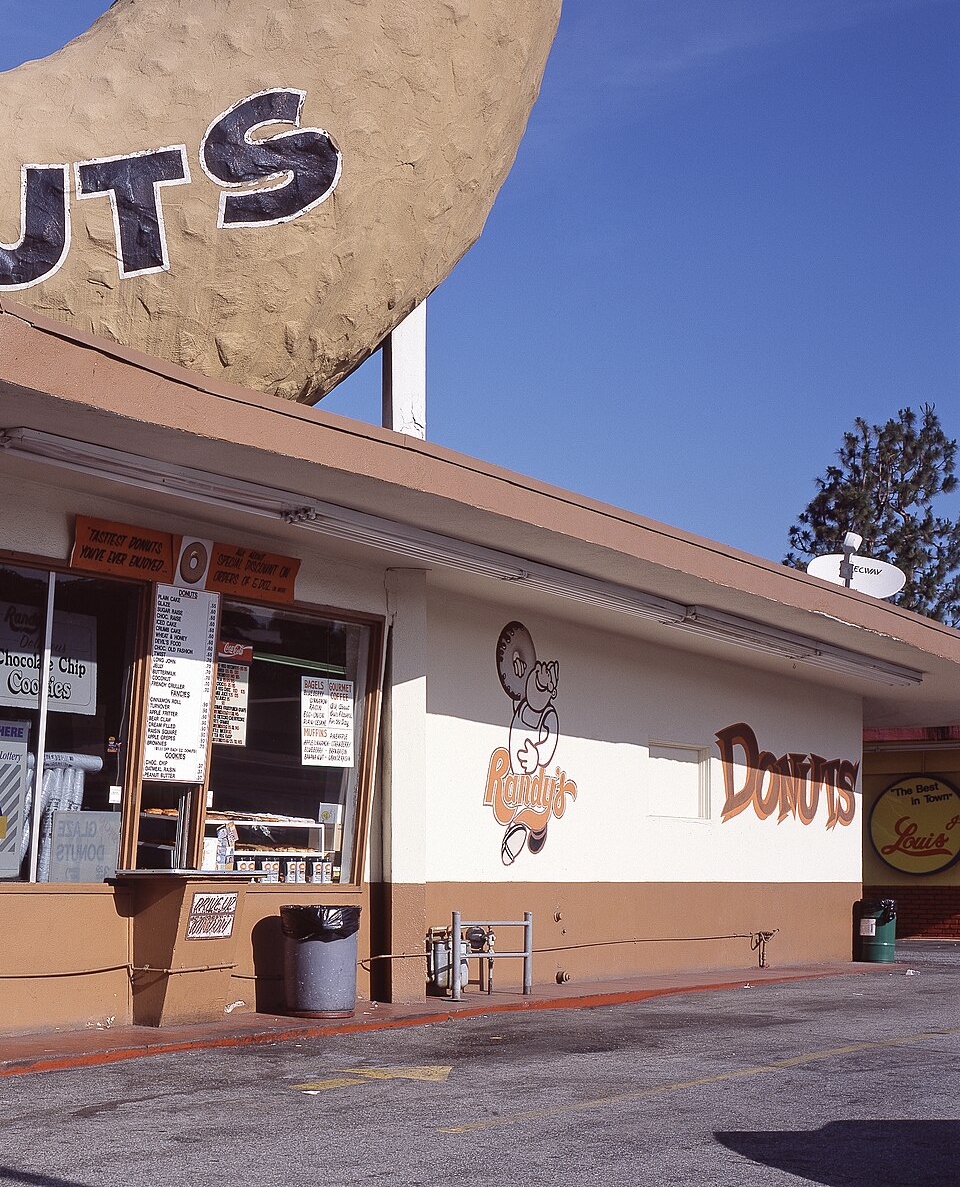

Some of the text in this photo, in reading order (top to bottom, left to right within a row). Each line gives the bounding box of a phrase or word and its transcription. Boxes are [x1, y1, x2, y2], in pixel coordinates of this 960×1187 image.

[128, 536, 162, 554] DONUTS
[80, 545, 106, 562] YOU'VE
[107, 550, 128, 565] EVER
[244, 560, 279, 575] DISCOUNT
[279, 566, 291, 578] ON
[213, 570, 239, 584] ORDERS
[242, 576, 251, 586] OF
[178, 589, 199, 598] DONUTS
[58, 656, 86, 678] Chip
[7, 669, 71, 700] Cooies
[304, 680, 324, 690] BAGELS
[329, 682, 352, 693] GOURMET
[330, 692, 349, 701] COFFEE
[304, 728, 327, 737] MUFFINS
[0, 751, 22, 763] Lottery
[165, 752, 186, 760] COOKIES
[715, 722, 860, 832] DONUTS
[483, 746, 577, 831] Randy's
[916, 782, 938, 794] Best
[911, 795, 920, 806] in
